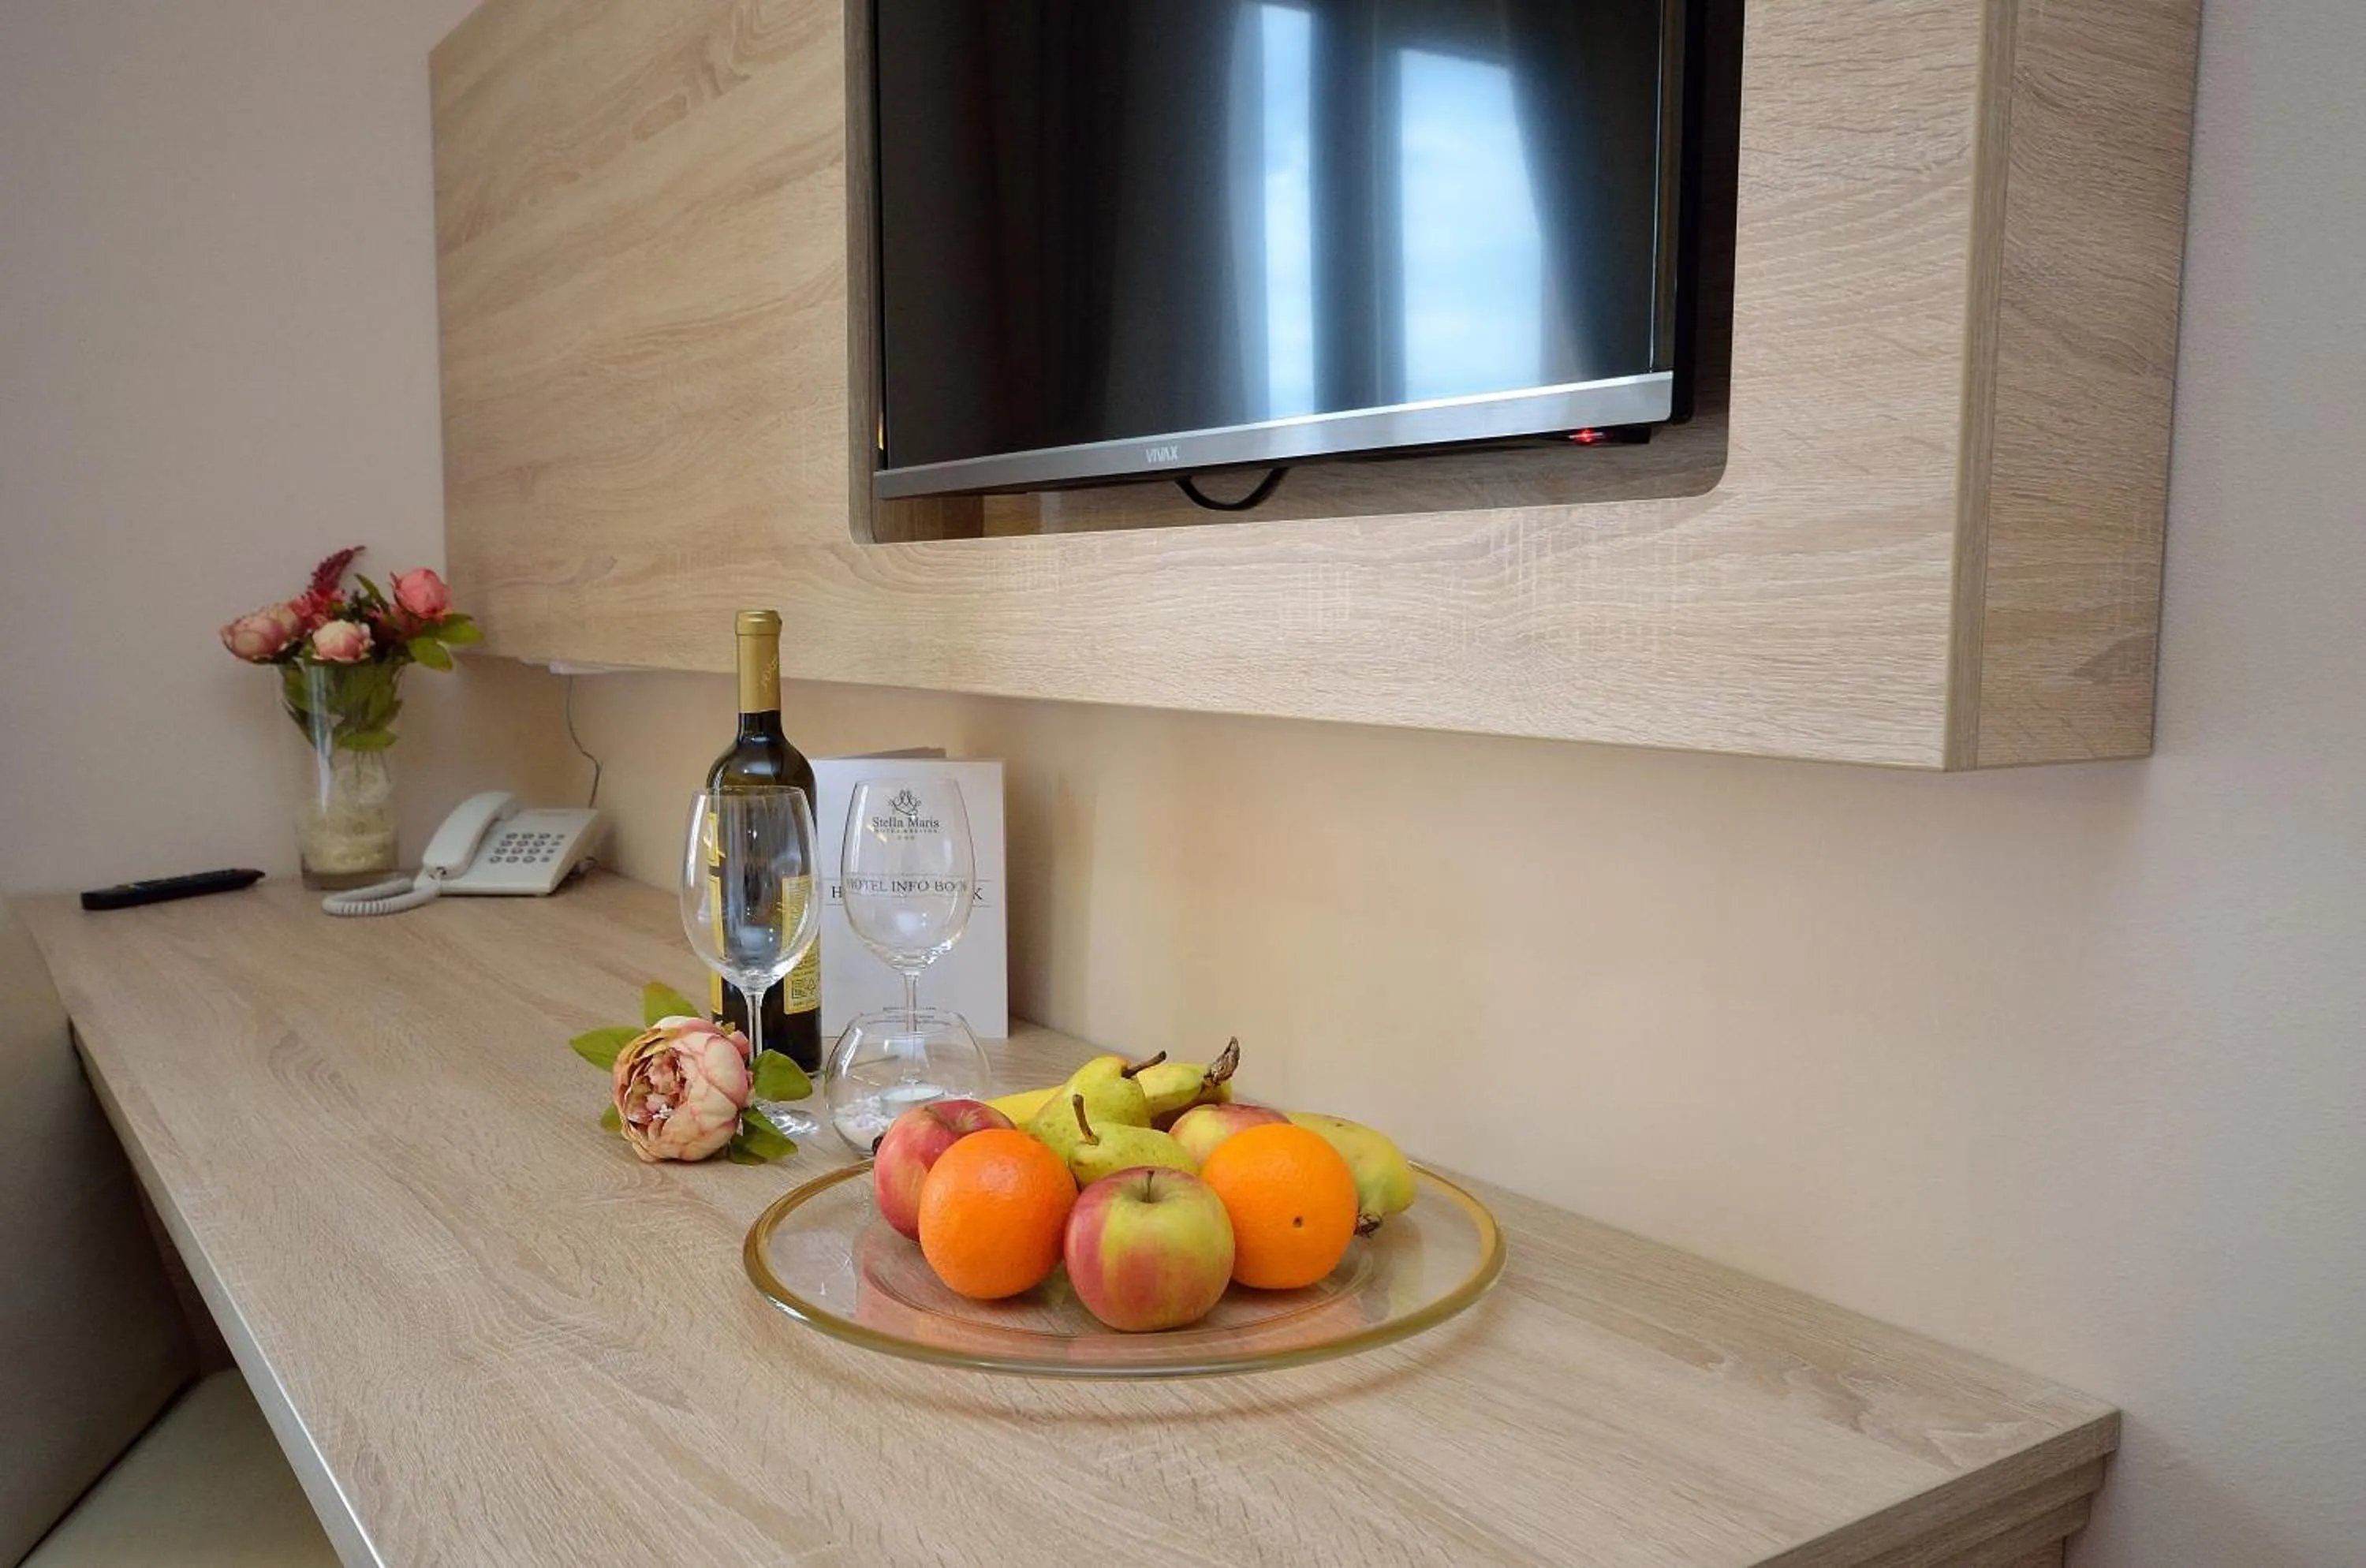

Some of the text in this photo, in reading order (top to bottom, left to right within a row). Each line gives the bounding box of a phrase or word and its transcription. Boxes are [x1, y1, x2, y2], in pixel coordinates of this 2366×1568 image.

[1145, 444, 1178, 464] VIVAX
[871, 816, 940, 827] Stella Maris
[891, 879, 929, 893] INFO
